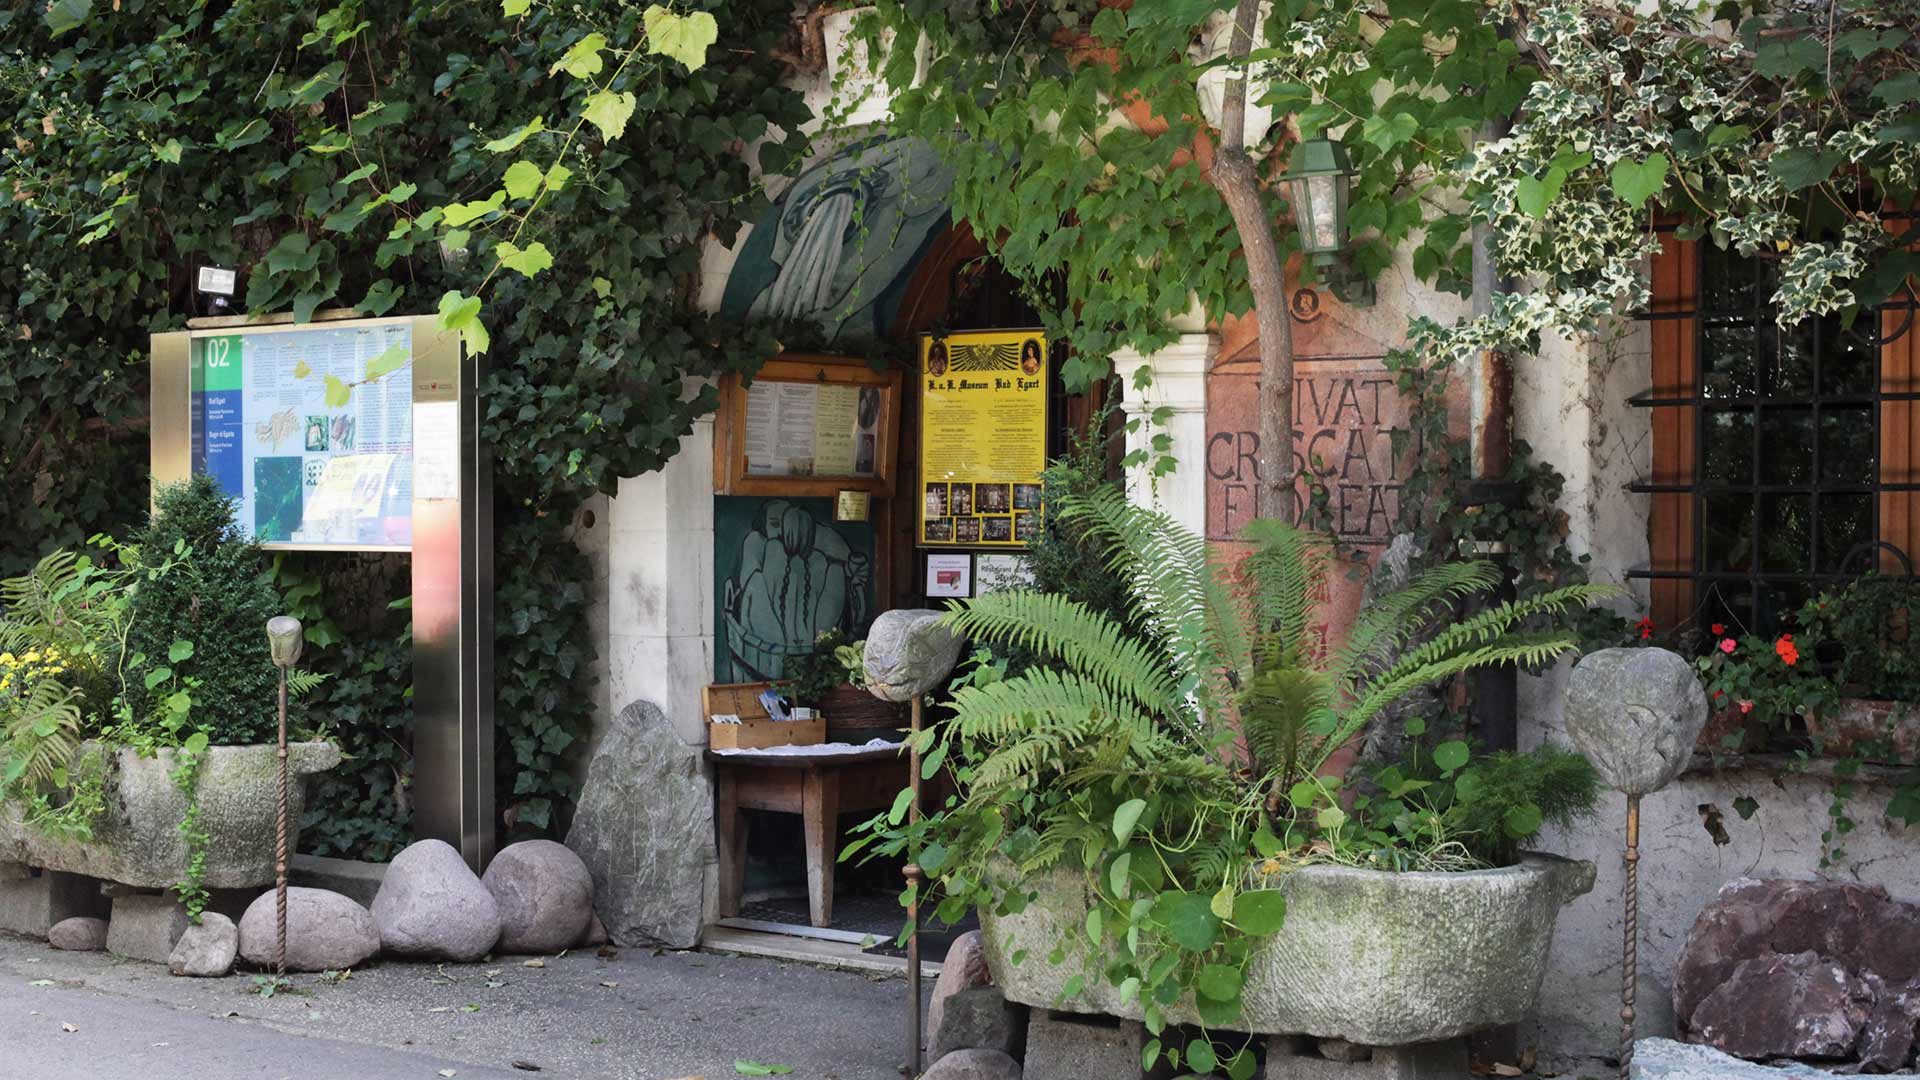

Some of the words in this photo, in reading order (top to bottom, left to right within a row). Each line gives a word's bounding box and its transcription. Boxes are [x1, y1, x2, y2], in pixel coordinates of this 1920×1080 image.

[208, 338, 230, 368] 02
[958, 379, 989, 392] Museum
[995, 377, 1011, 392] Bad
[1016, 377, 1040, 392] Egart
[1255, 378, 1395, 426] IVAT
[1206, 429, 1410, 482] CRSCAT
